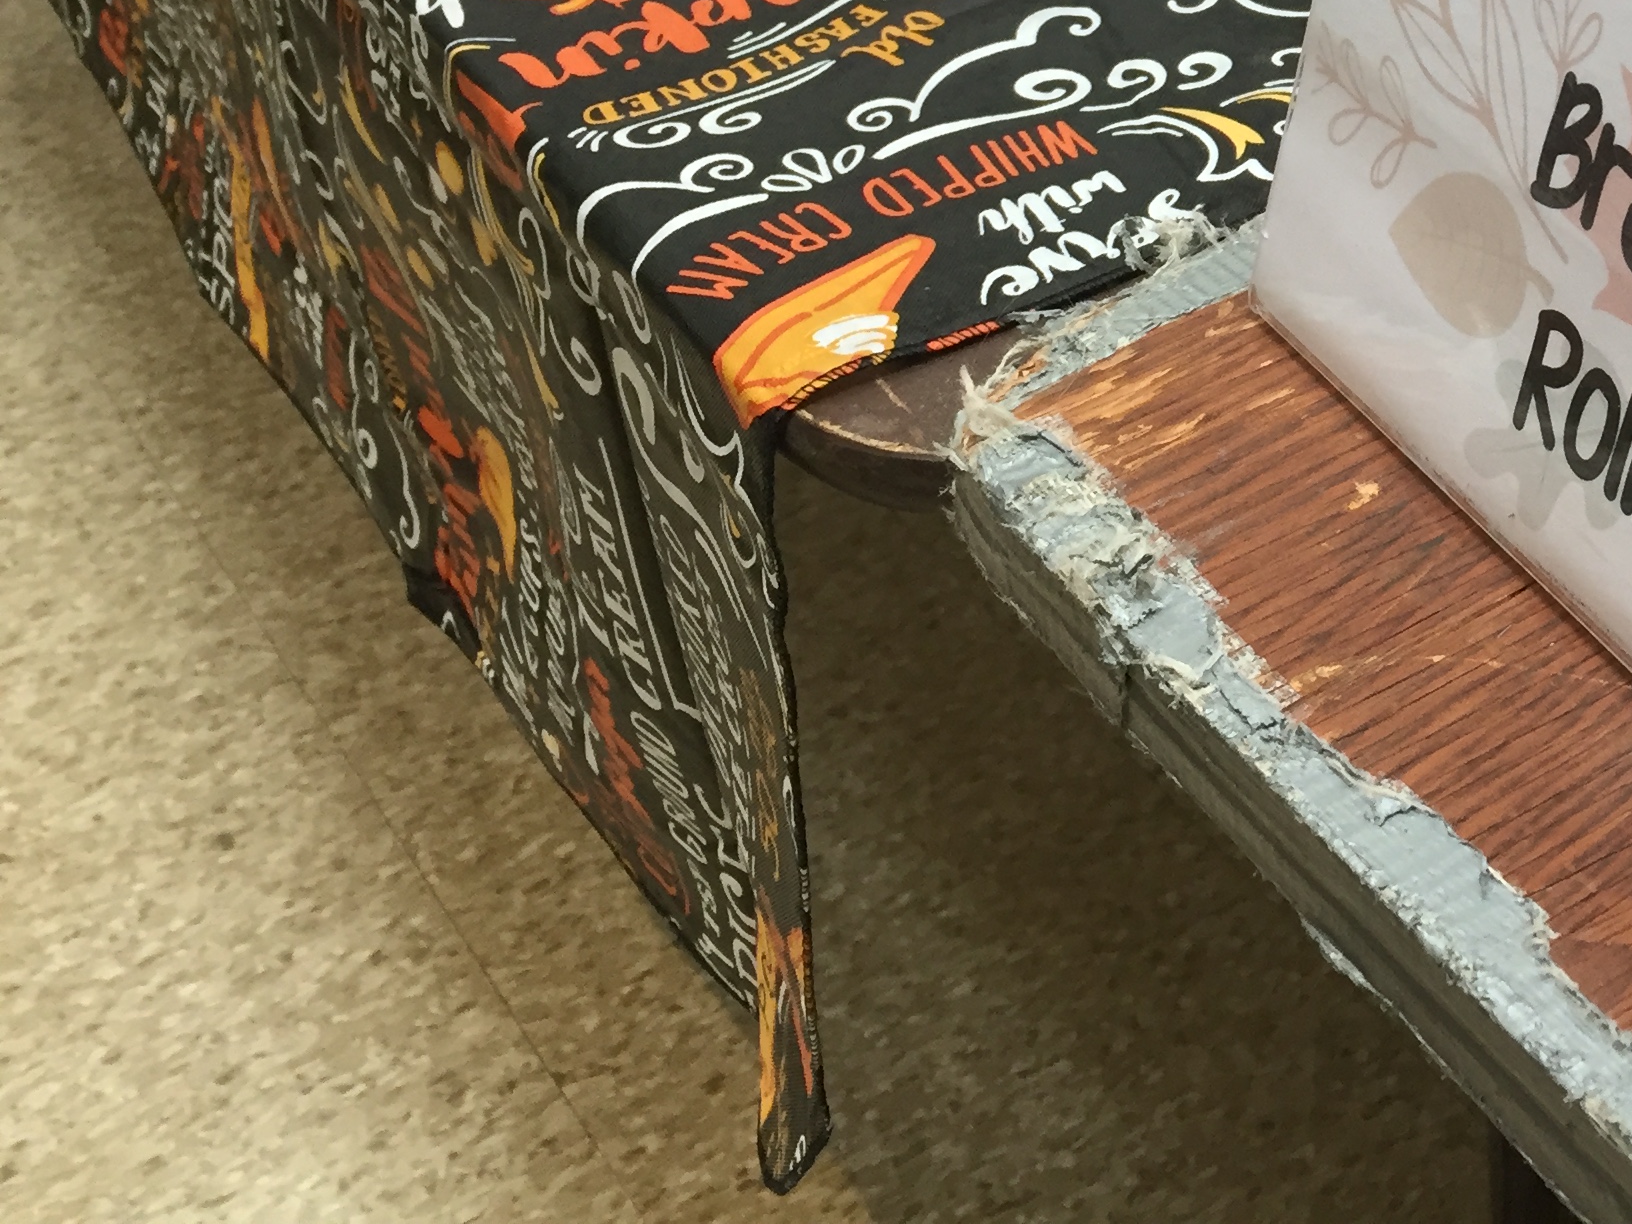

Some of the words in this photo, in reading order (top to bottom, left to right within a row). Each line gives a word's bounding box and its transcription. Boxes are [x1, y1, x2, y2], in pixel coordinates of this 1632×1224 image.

[581, 1, 894, 128] FASHIONED
[861, 119, 1099, 218] WHIPPED
[978, 169, 1128, 246] with
[663, 200, 855, 303] CREAM
